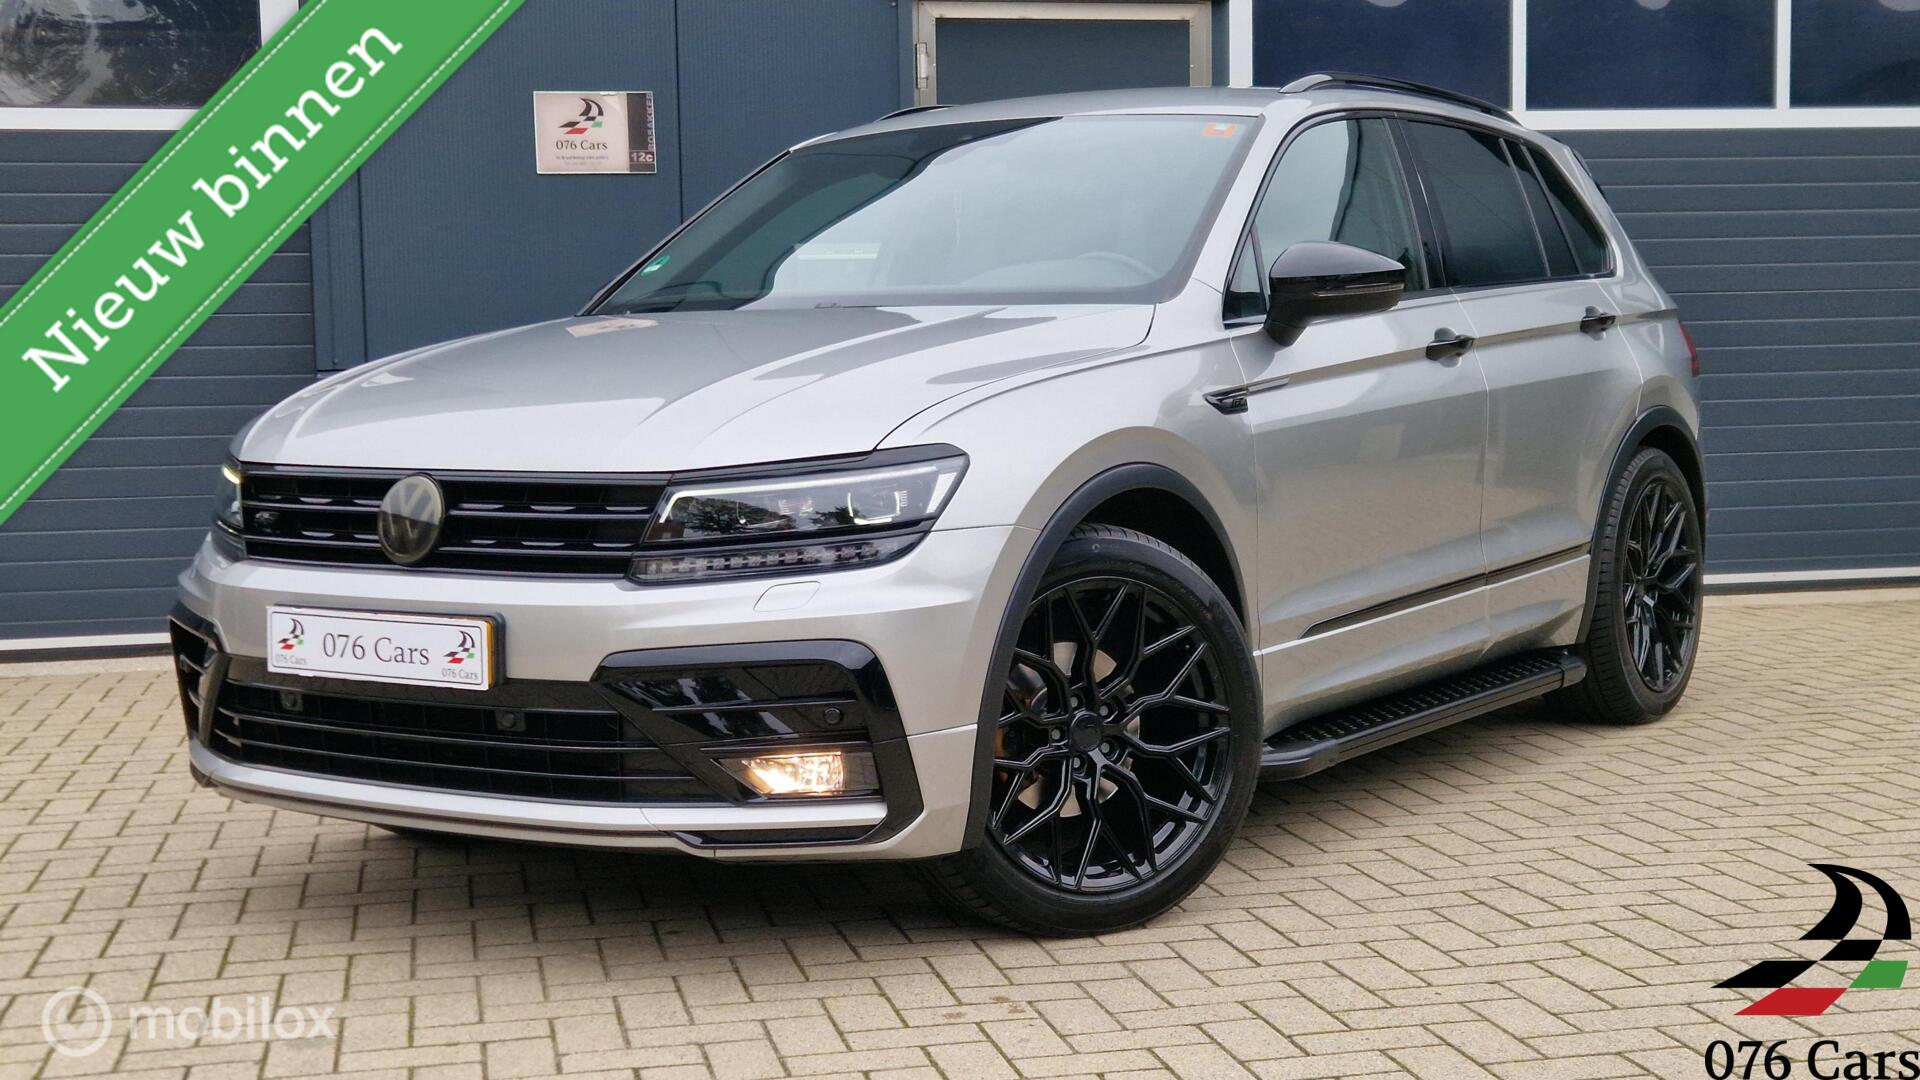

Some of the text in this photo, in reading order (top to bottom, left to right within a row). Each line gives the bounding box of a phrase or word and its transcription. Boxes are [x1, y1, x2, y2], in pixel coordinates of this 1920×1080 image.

[555, 140, 608, 150] 076 Cars
[631, 152, 653, 162] 12c
[322, 632, 430, 665] 076 Cars
[441, 667, 479, 681] 076 Cars
